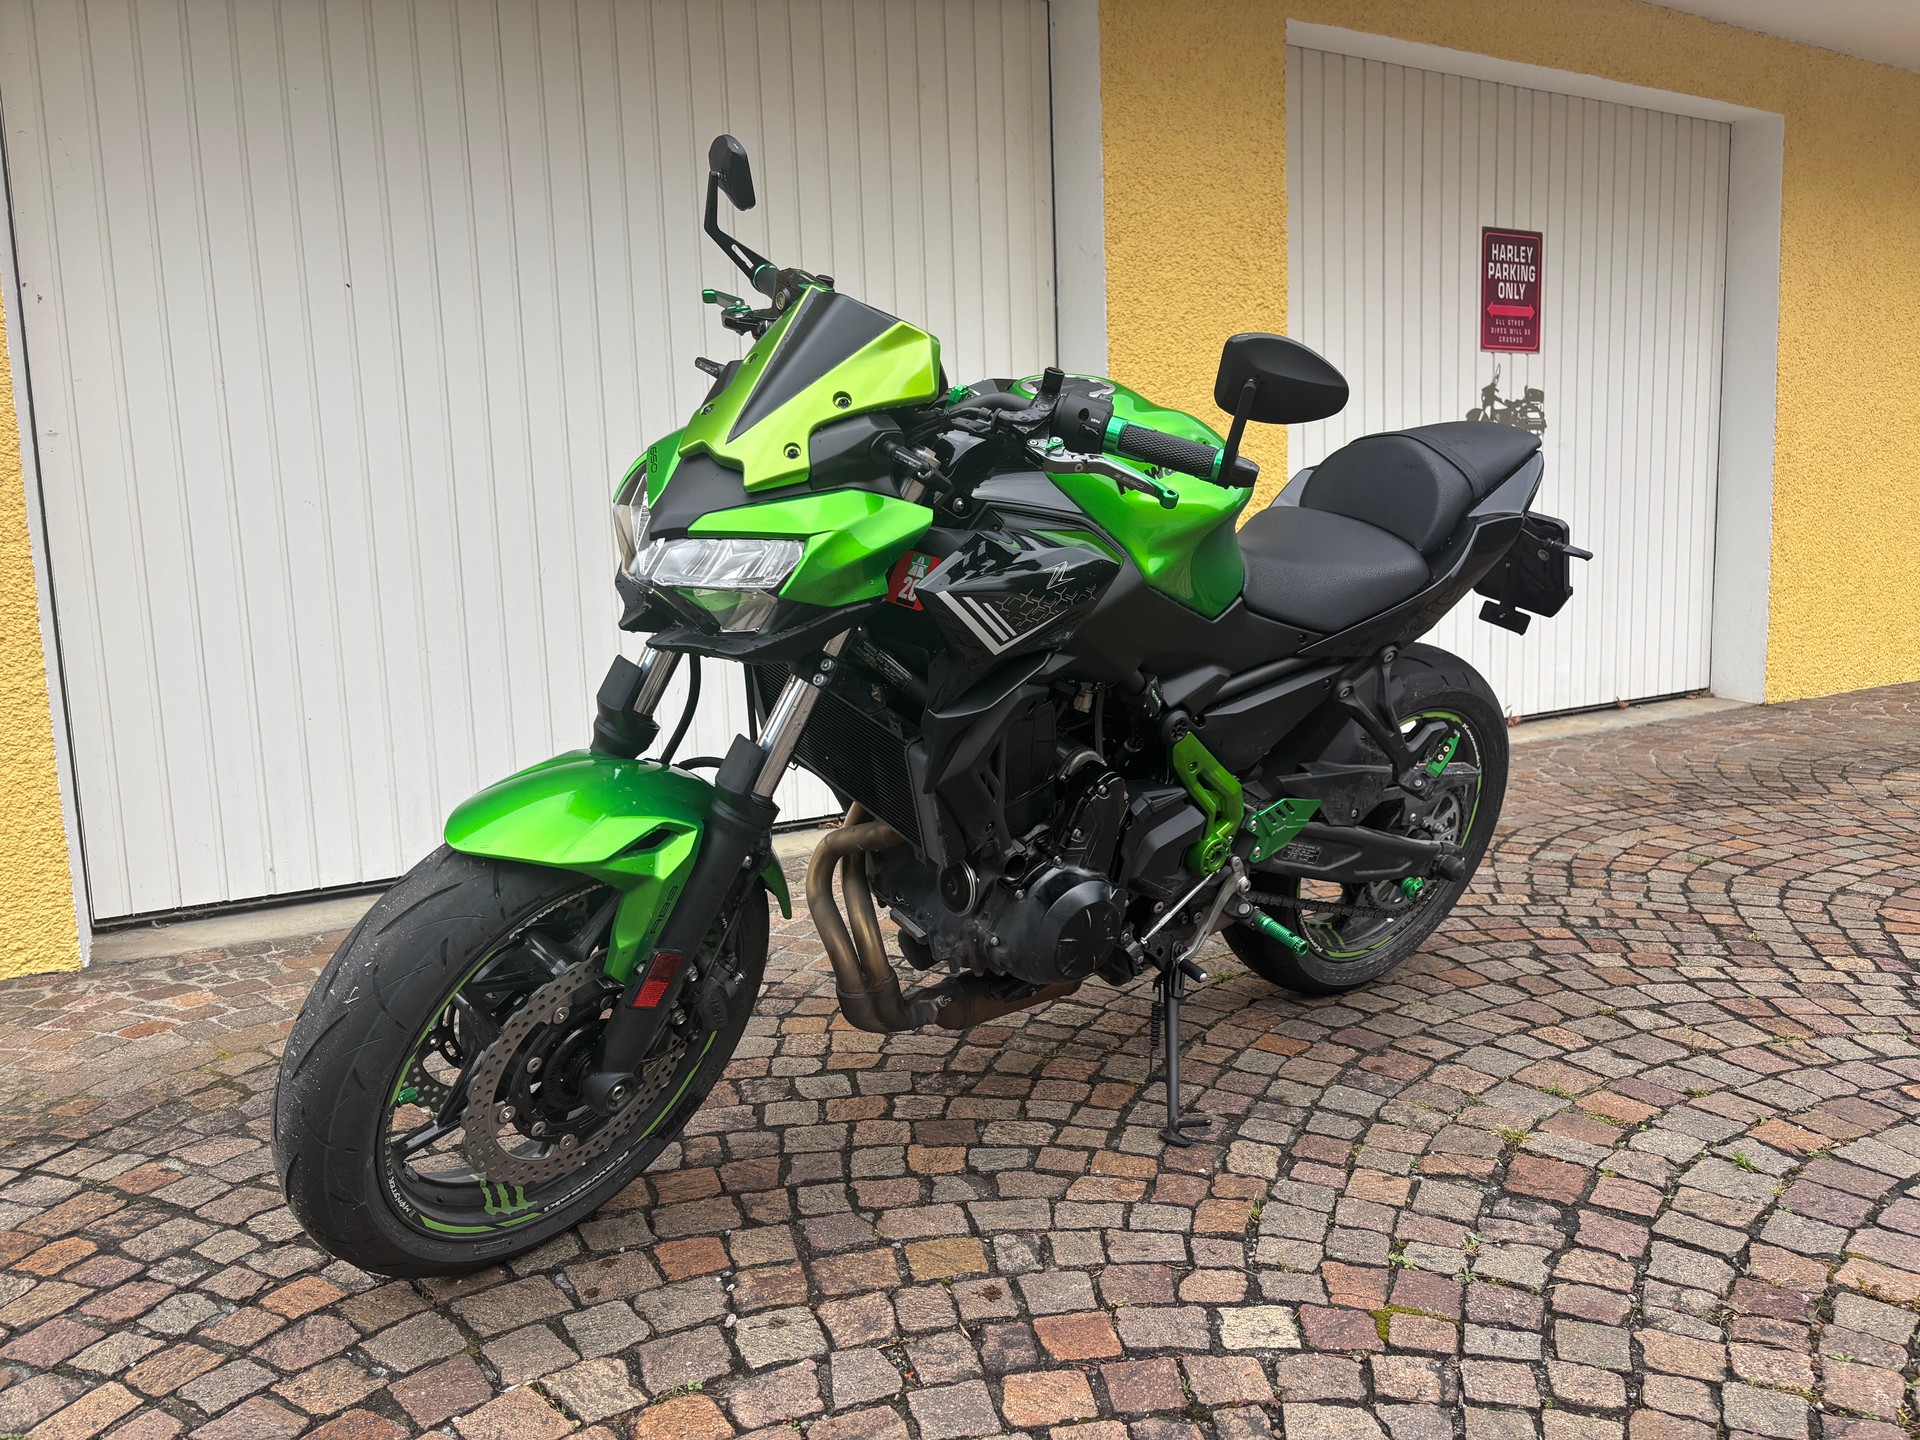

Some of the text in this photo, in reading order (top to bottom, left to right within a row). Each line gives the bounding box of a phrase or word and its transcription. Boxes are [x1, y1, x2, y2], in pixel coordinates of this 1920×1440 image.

[1491, 243, 1534, 264] HARLEY
[1488, 262, 1536, 283] PARKING
[1497, 281, 1526, 300] ONLY
[1490, 326, 1507, 334] BIKES
[1509, 328, 1522, 336] WILL
[1495, 318, 1525, 327] ALL OTHER
[1498, 336, 1523, 344] CRUSHED
[650, 446, 658, 474] 650
[650, 885, 679, 935] ABS
